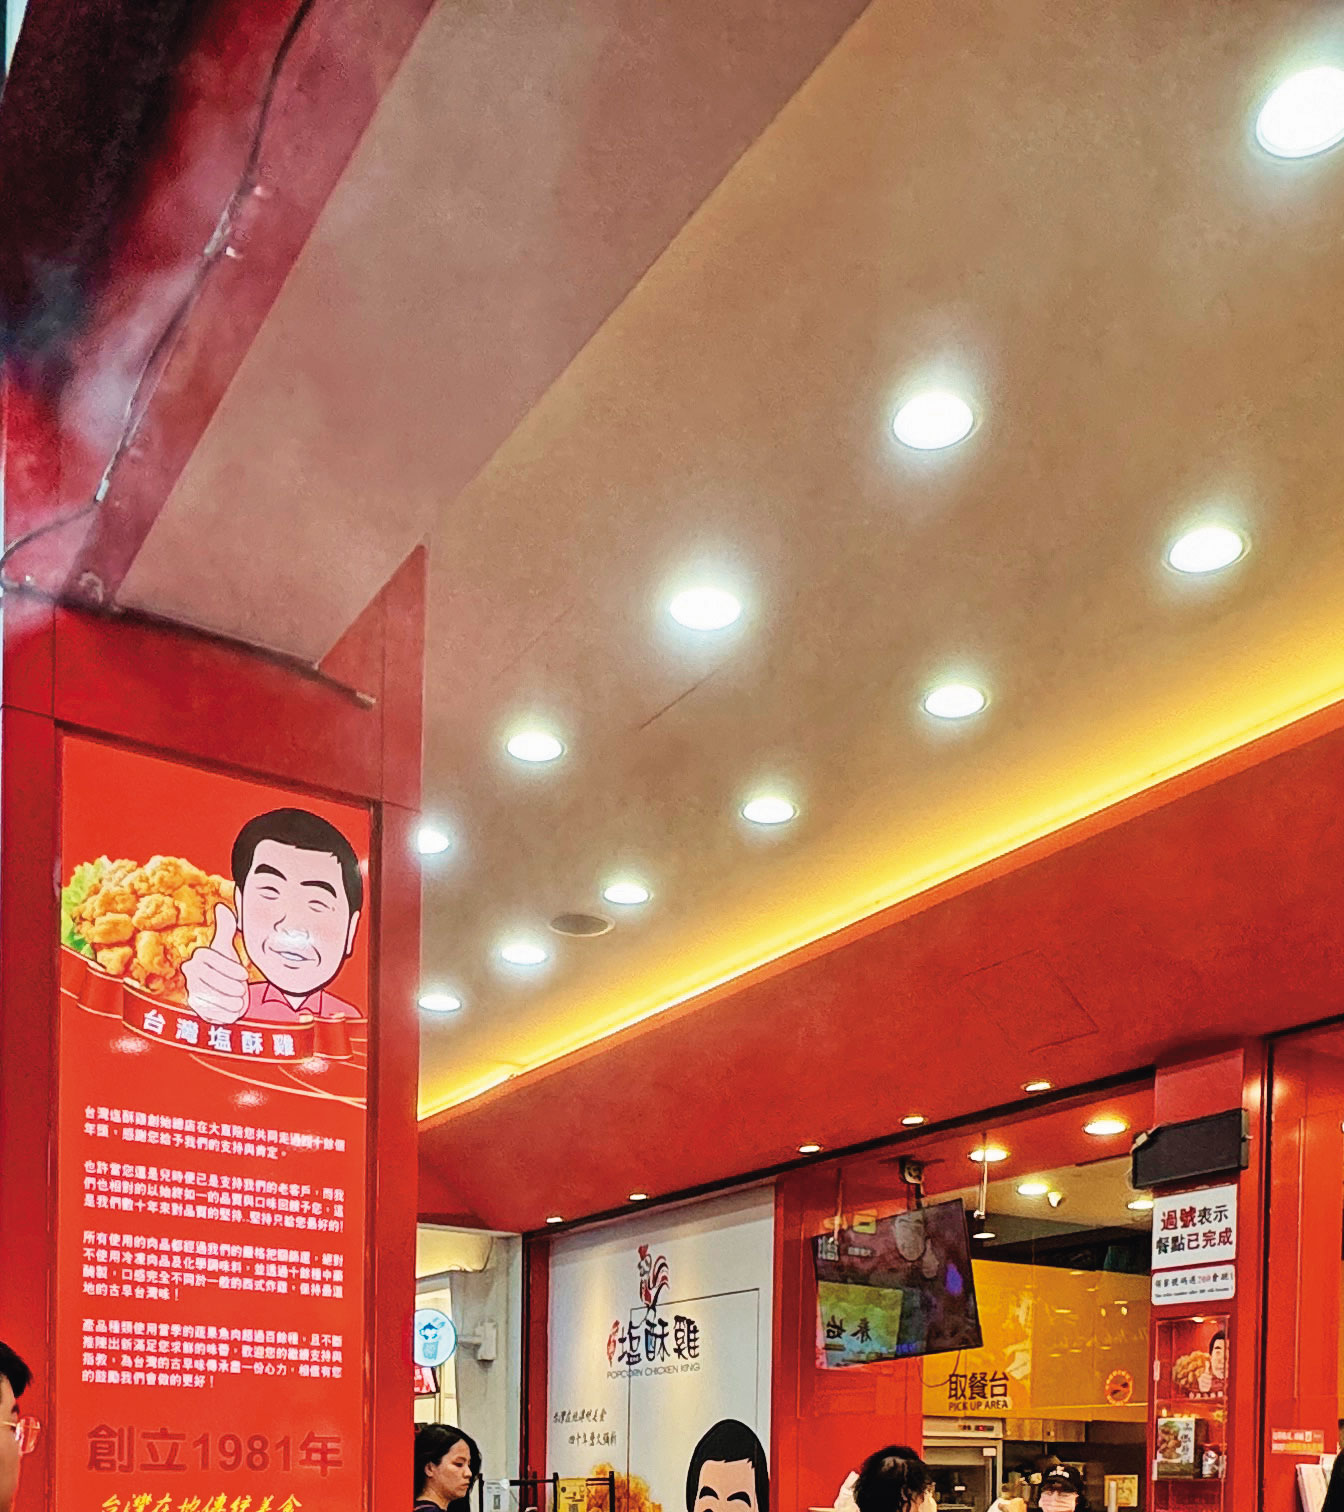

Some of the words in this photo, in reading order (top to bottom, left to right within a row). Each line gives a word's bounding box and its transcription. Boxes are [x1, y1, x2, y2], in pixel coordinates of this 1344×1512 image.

[142, 1009, 297, 1058] 台灣塩酥雞
[1161, 1204, 1229, 1231] 過號表示
[1156, 1227, 1233, 1255] 餐點已完成
[948, 1370, 1009, 1400] 取餐台
[949, 1402, 968, 1411] PICK
[970, 1402, 982, 1410] UP
[985, 1400, 1008, 1410] AREA
[87, 1424, 344, 1477] 創立1981年
